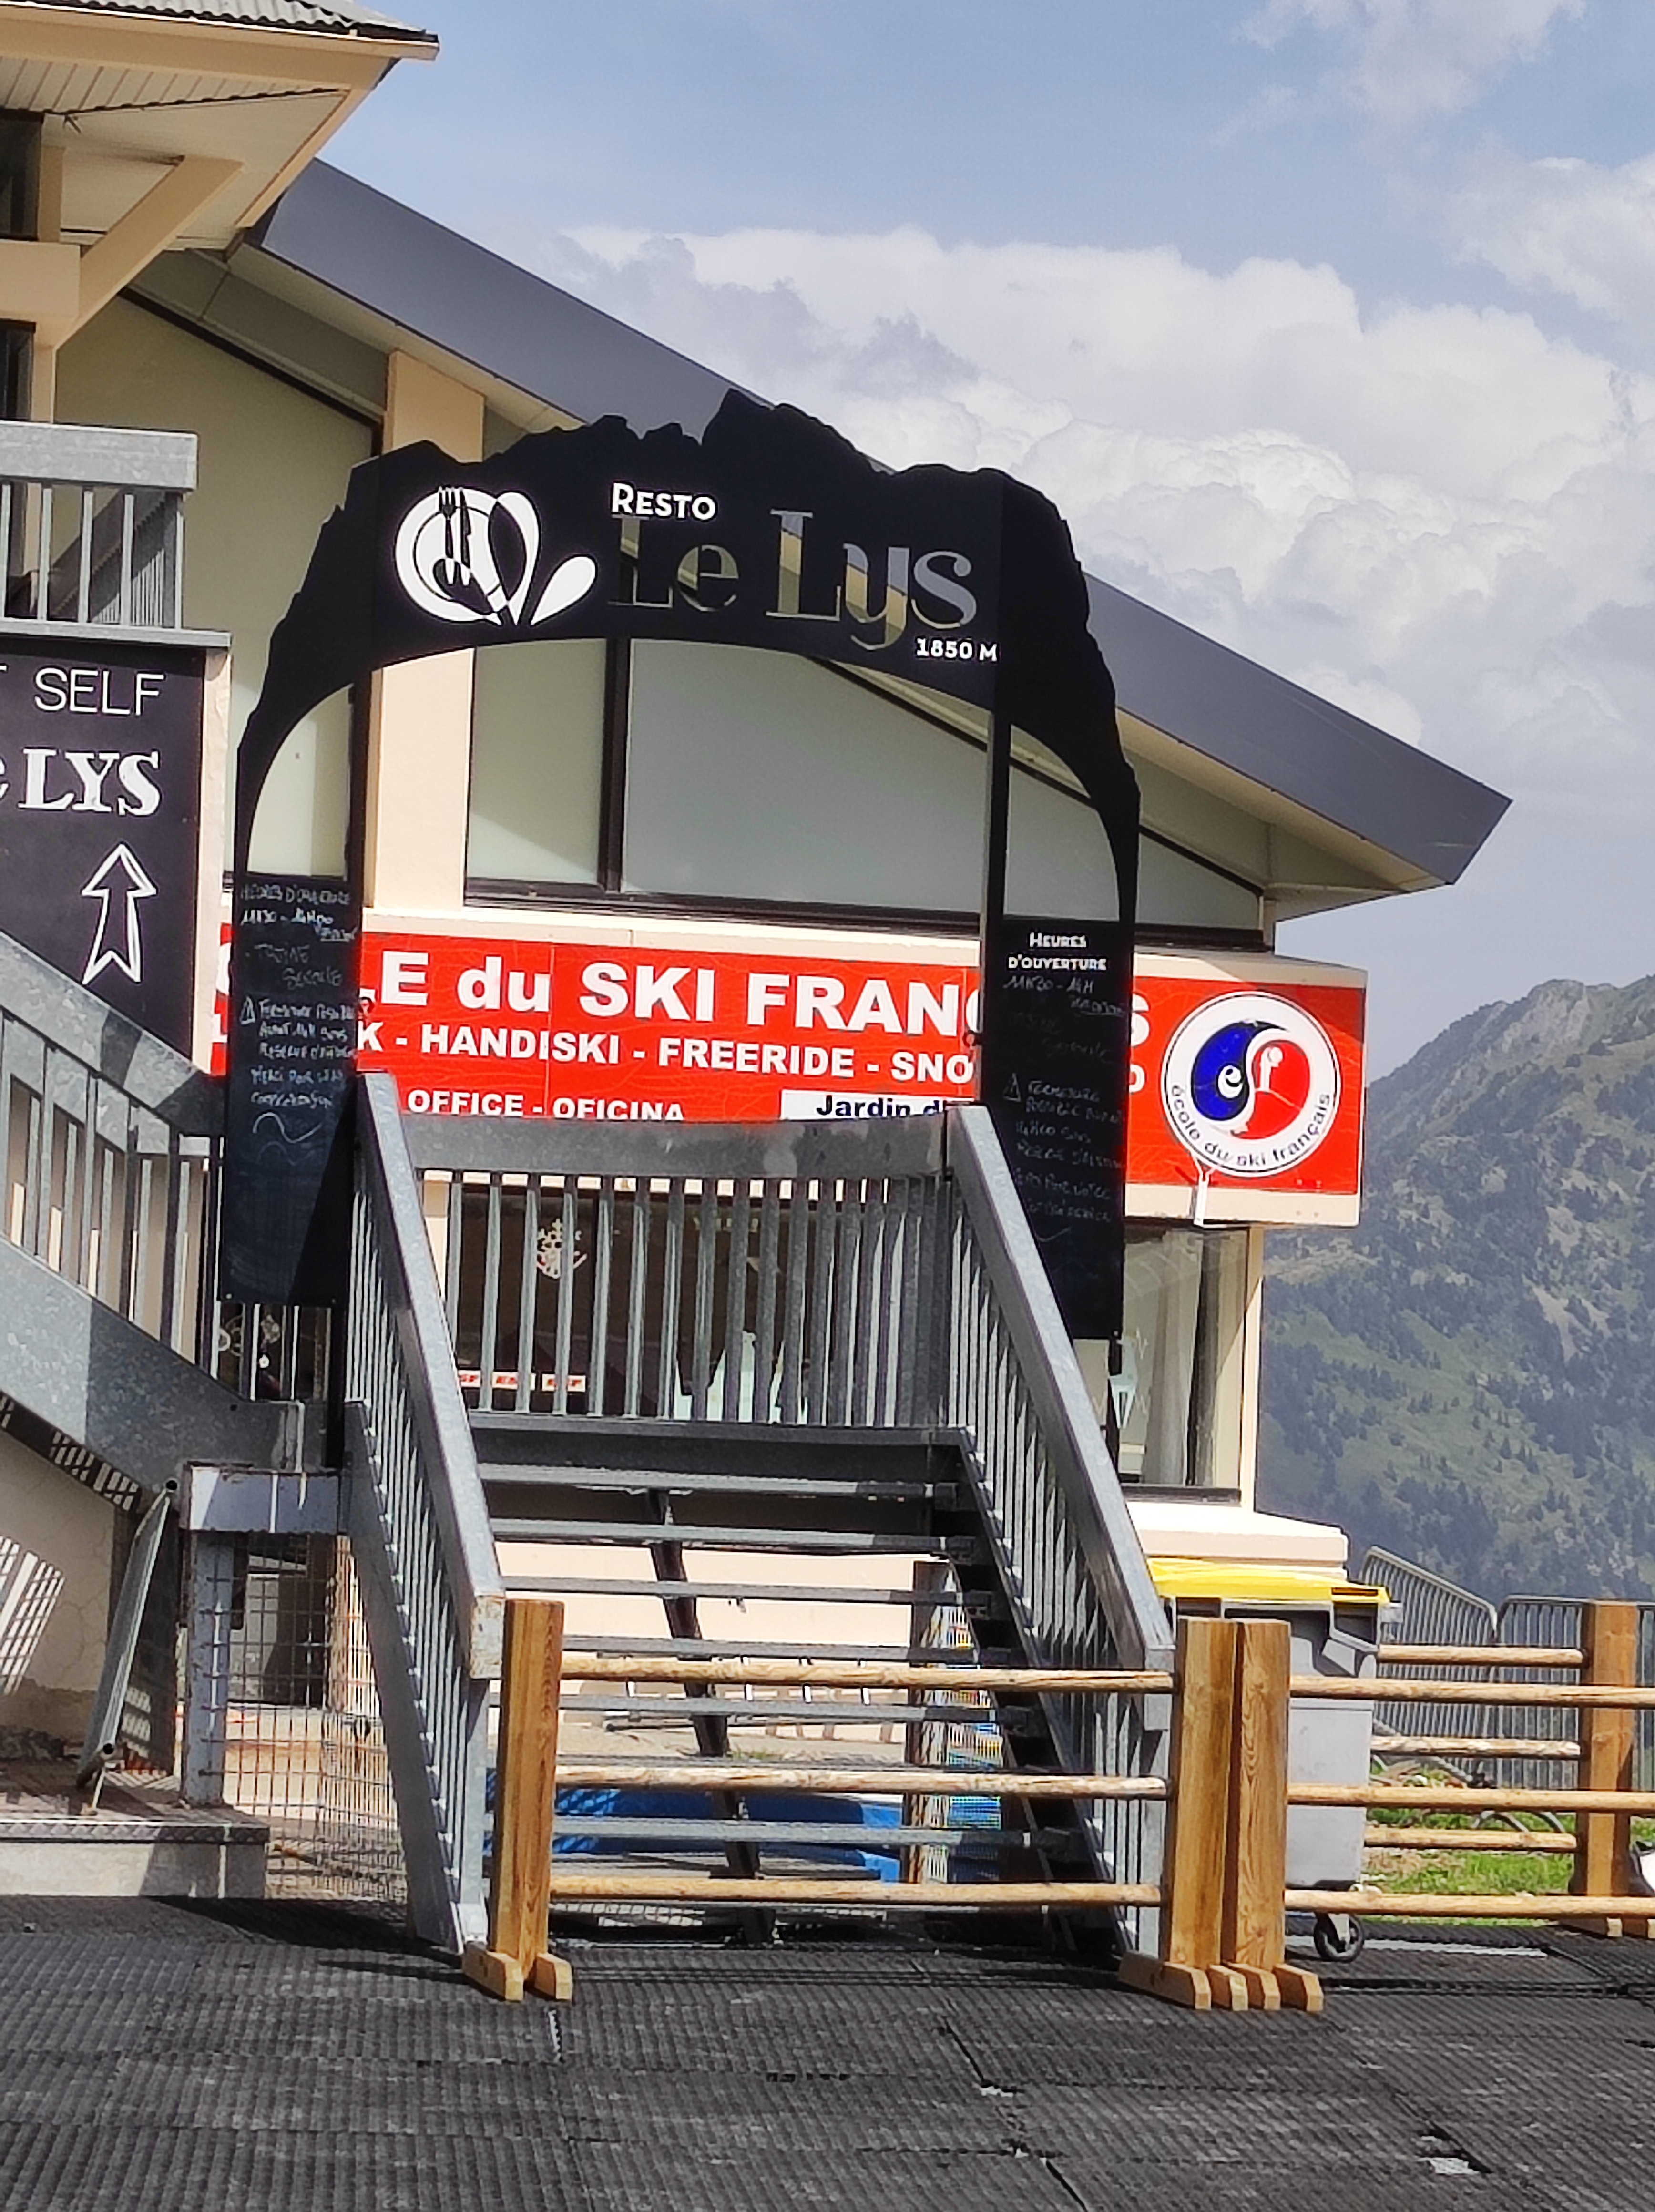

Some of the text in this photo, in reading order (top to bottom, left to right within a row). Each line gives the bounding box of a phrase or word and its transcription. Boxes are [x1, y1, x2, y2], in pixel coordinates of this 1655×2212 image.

[612, 482, 716, 521] RESTO
[608, 508, 977, 651] Le Lys
[915, 637, 998, 662] 1850 M
[35, 667, 165, 716] SELF
[18, 748, 162, 816] LYS
[1029, 932, 1087, 948] HEURES
[1008, 954, 1107, 971] D'OUVERTURE
[457, 956, 551, 1012] du
[579, 962, 715, 1022] SKI
[421, 1024, 619, 1064] HANDISKI
[659, 1038, 855, 1078] FREERIDE
[408, 1089, 523, 1116] OFFICE
[552, 1097, 684, 1121] OFICINA
[816, 1095, 911, 1118] Jardin
[1204, 1142, 1231, 1161] du
